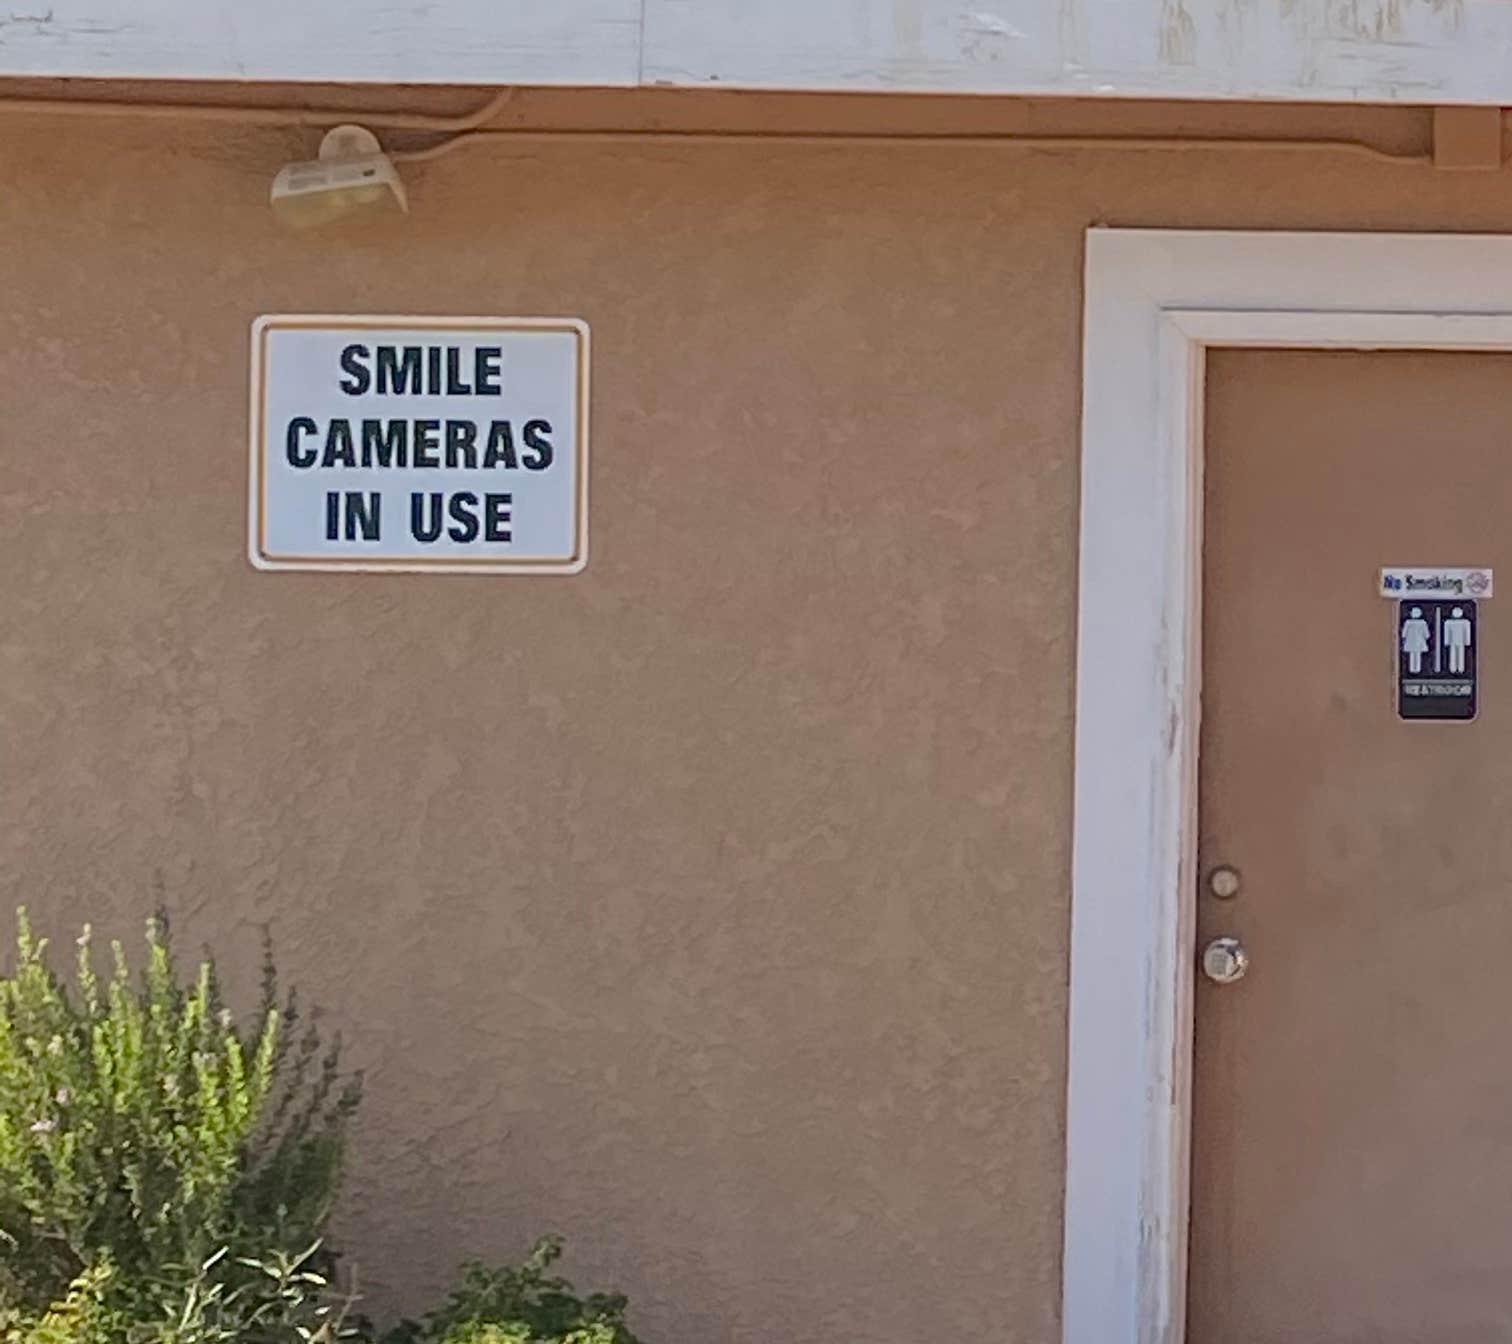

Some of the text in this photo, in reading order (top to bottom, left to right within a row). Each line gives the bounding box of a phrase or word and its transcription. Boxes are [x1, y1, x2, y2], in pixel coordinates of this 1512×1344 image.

[338, 344, 503, 396] SMILE
[285, 416, 554, 471] CAMERAS
[325, 491, 513, 544] IN USE
[1383, 574, 1463, 595] No Smoking
